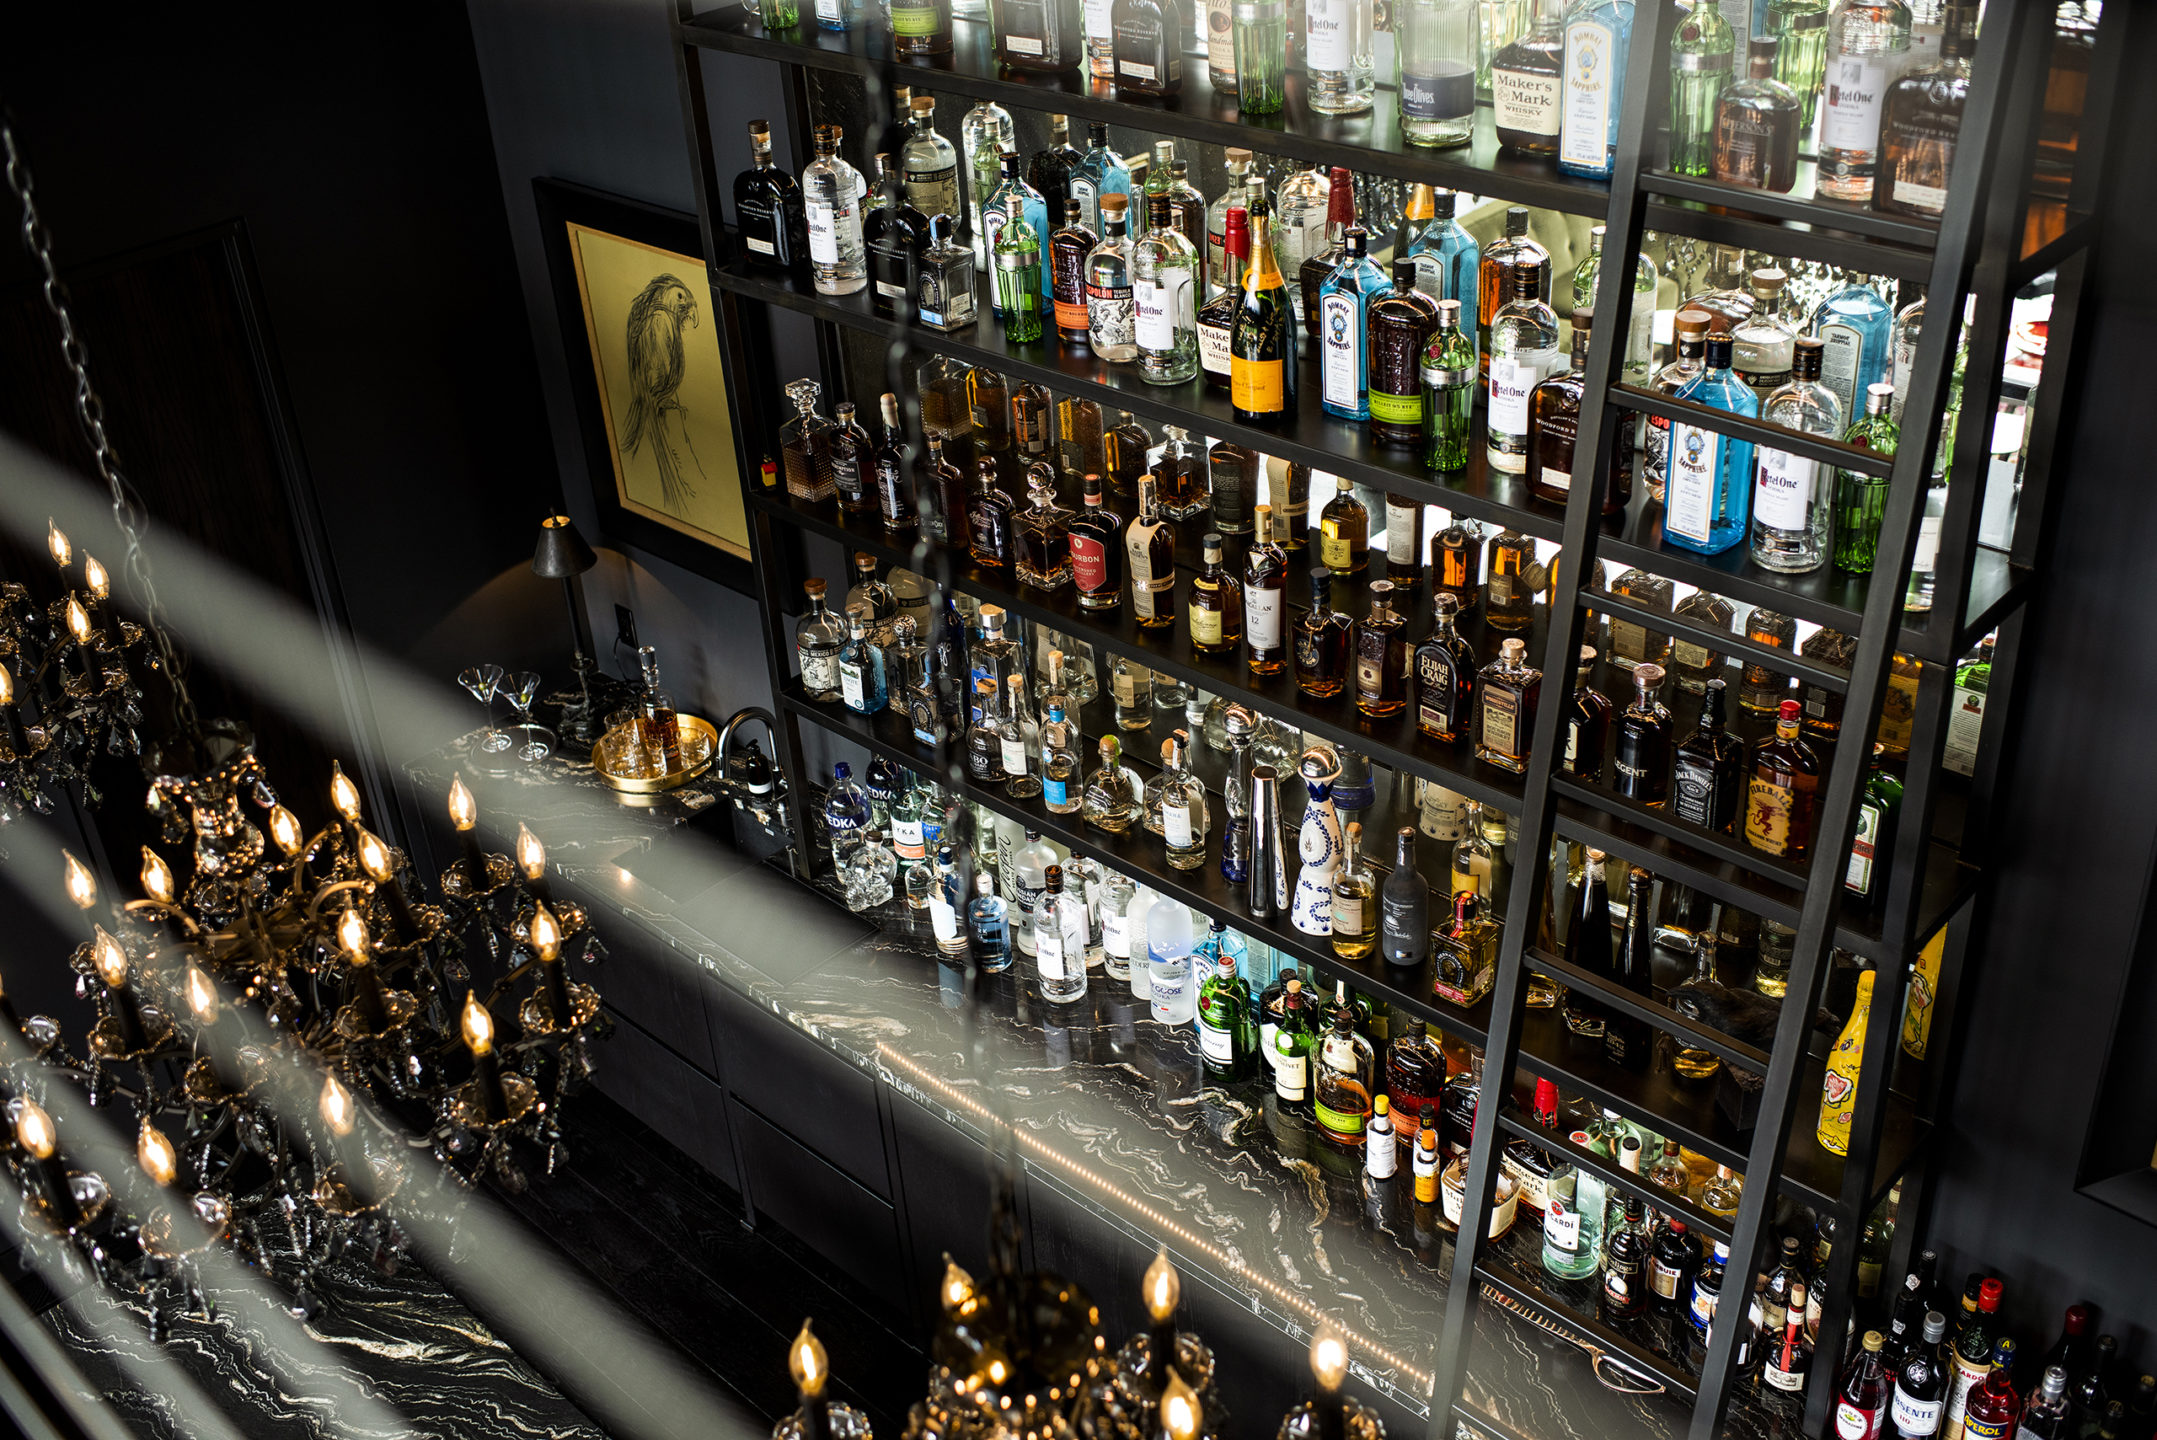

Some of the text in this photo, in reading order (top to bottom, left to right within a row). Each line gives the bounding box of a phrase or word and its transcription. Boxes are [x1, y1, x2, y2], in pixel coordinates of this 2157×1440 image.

[1497, 74, 1552, 92] Maker's
[1853, 90, 1873, 103] One
[1505, 105, 1542, 116] WHISKY
[1200, 327, 1229, 342] Make
[1212, 341, 1229, 353] Ma
[1207, 352, 1231, 361] WHISK
[1509, 387, 1525, 398] One
[1651, 414, 1670, 429] ESPO
[1779, 477, 1798, 489] One
[1071, 551, 1100, 563] OURBON
[1251, 615, 1259, 625] 12
[1420, 655, 1448, 675] ELIJAH
[1420, 666, 1448, 685] CRAIG
[1749, 783, 1791, 809] FIREBALL
[826, 814, 857, 828] EDKA
[998, 835, 1017, 903] Chopin
[1958, 1368, 1984, 1381] ARDO
[1895, 1396, 1934, 1419] BSENTE
[1963, 1415, 2001, 1436] APEROL
